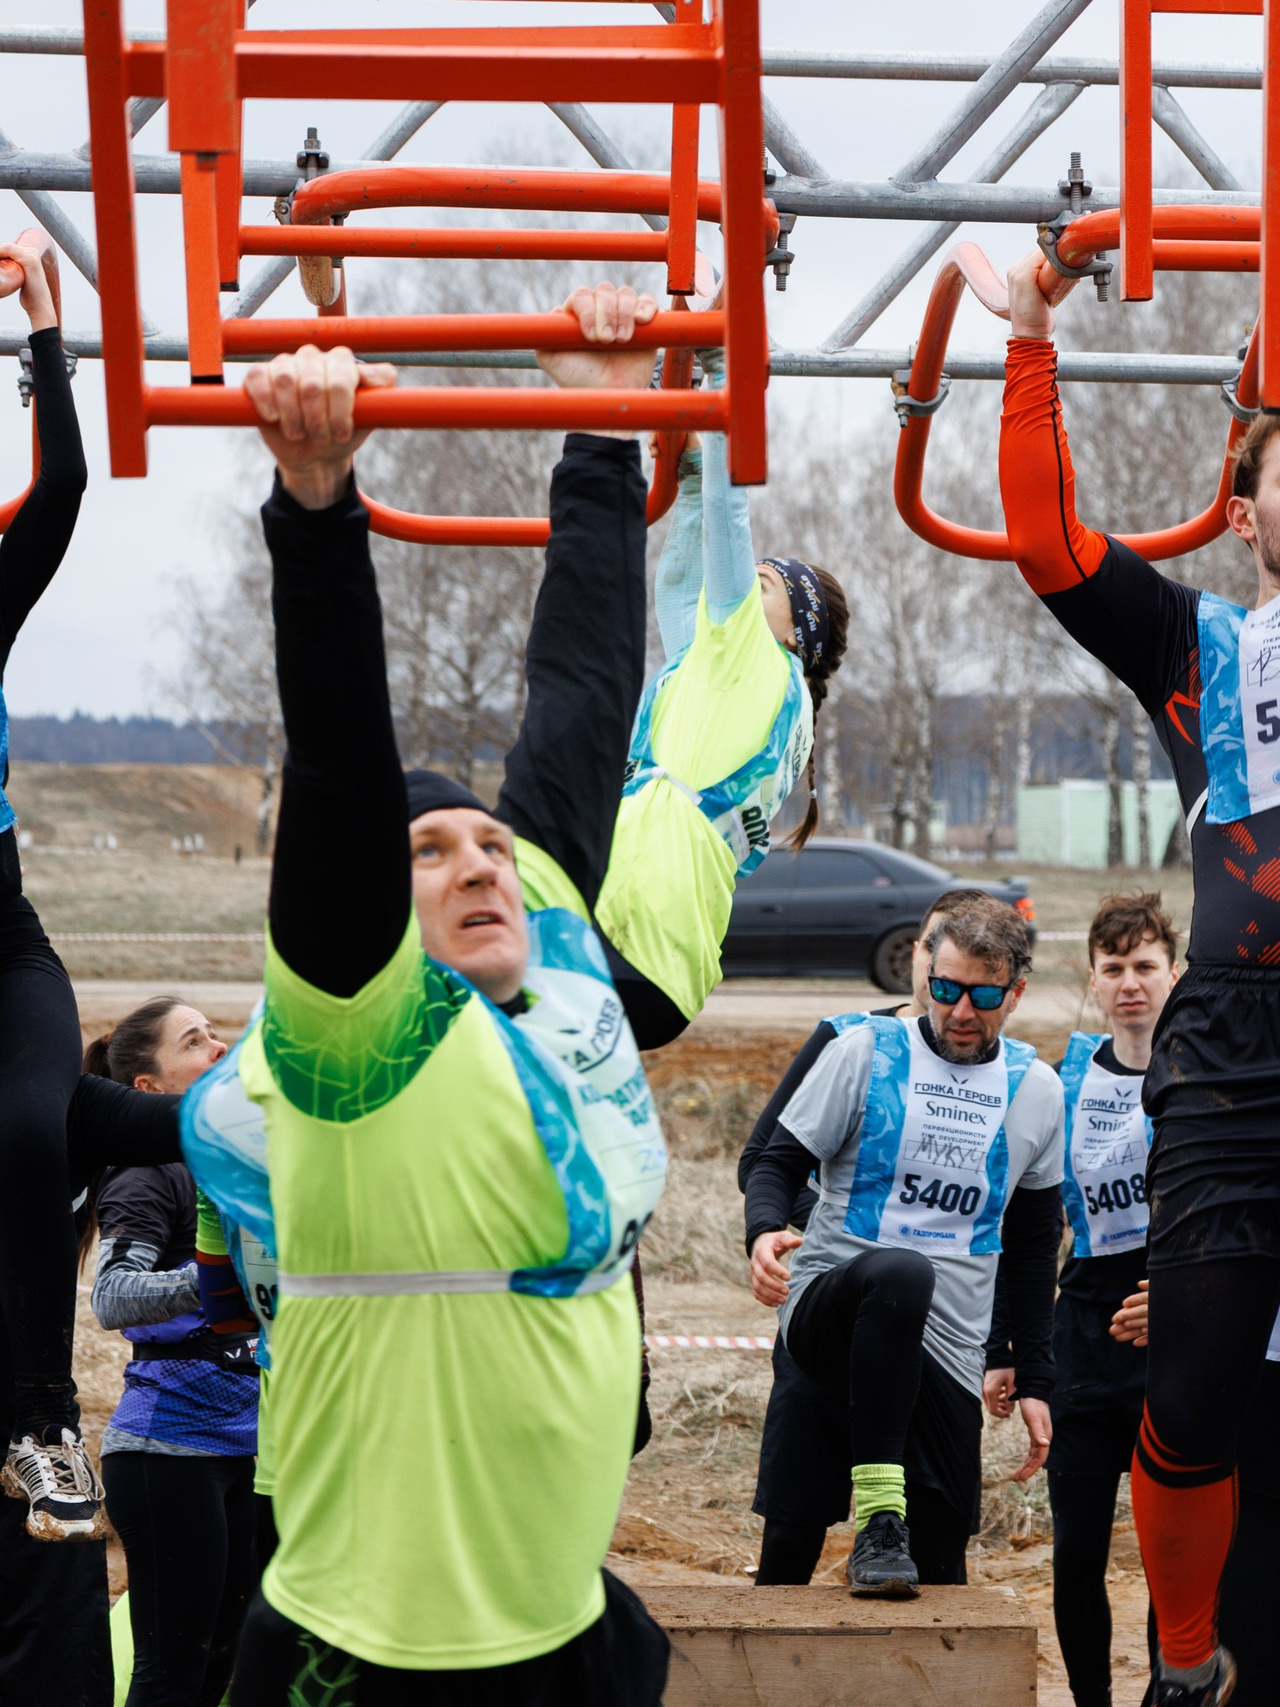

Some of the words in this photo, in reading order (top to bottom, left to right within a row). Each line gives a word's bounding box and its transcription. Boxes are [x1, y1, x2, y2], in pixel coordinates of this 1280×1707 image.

[914, 1082, 955, 1096] ГОНКА
[958, 1088, 1002, 1105] ГЕРОЕВ
[1081, 1098, 1116, 1110] ГОНКА
[925, 1100, 987, 1126] Sminex
[923, 1123, 987, 1139] ПЕРФЕКЦИОНИСТЫ
[938, 1135, 986, 1147] DEVELOPMENT
[899, 1173, 982, 1216] 5400
[1084, 1173, 1146, 1216] 5408
[913, 1229, 957, 1240] ГАЗПРОМБАНК
[1110, 1224, 1149, 1241] ГАЗПРОМБАН
